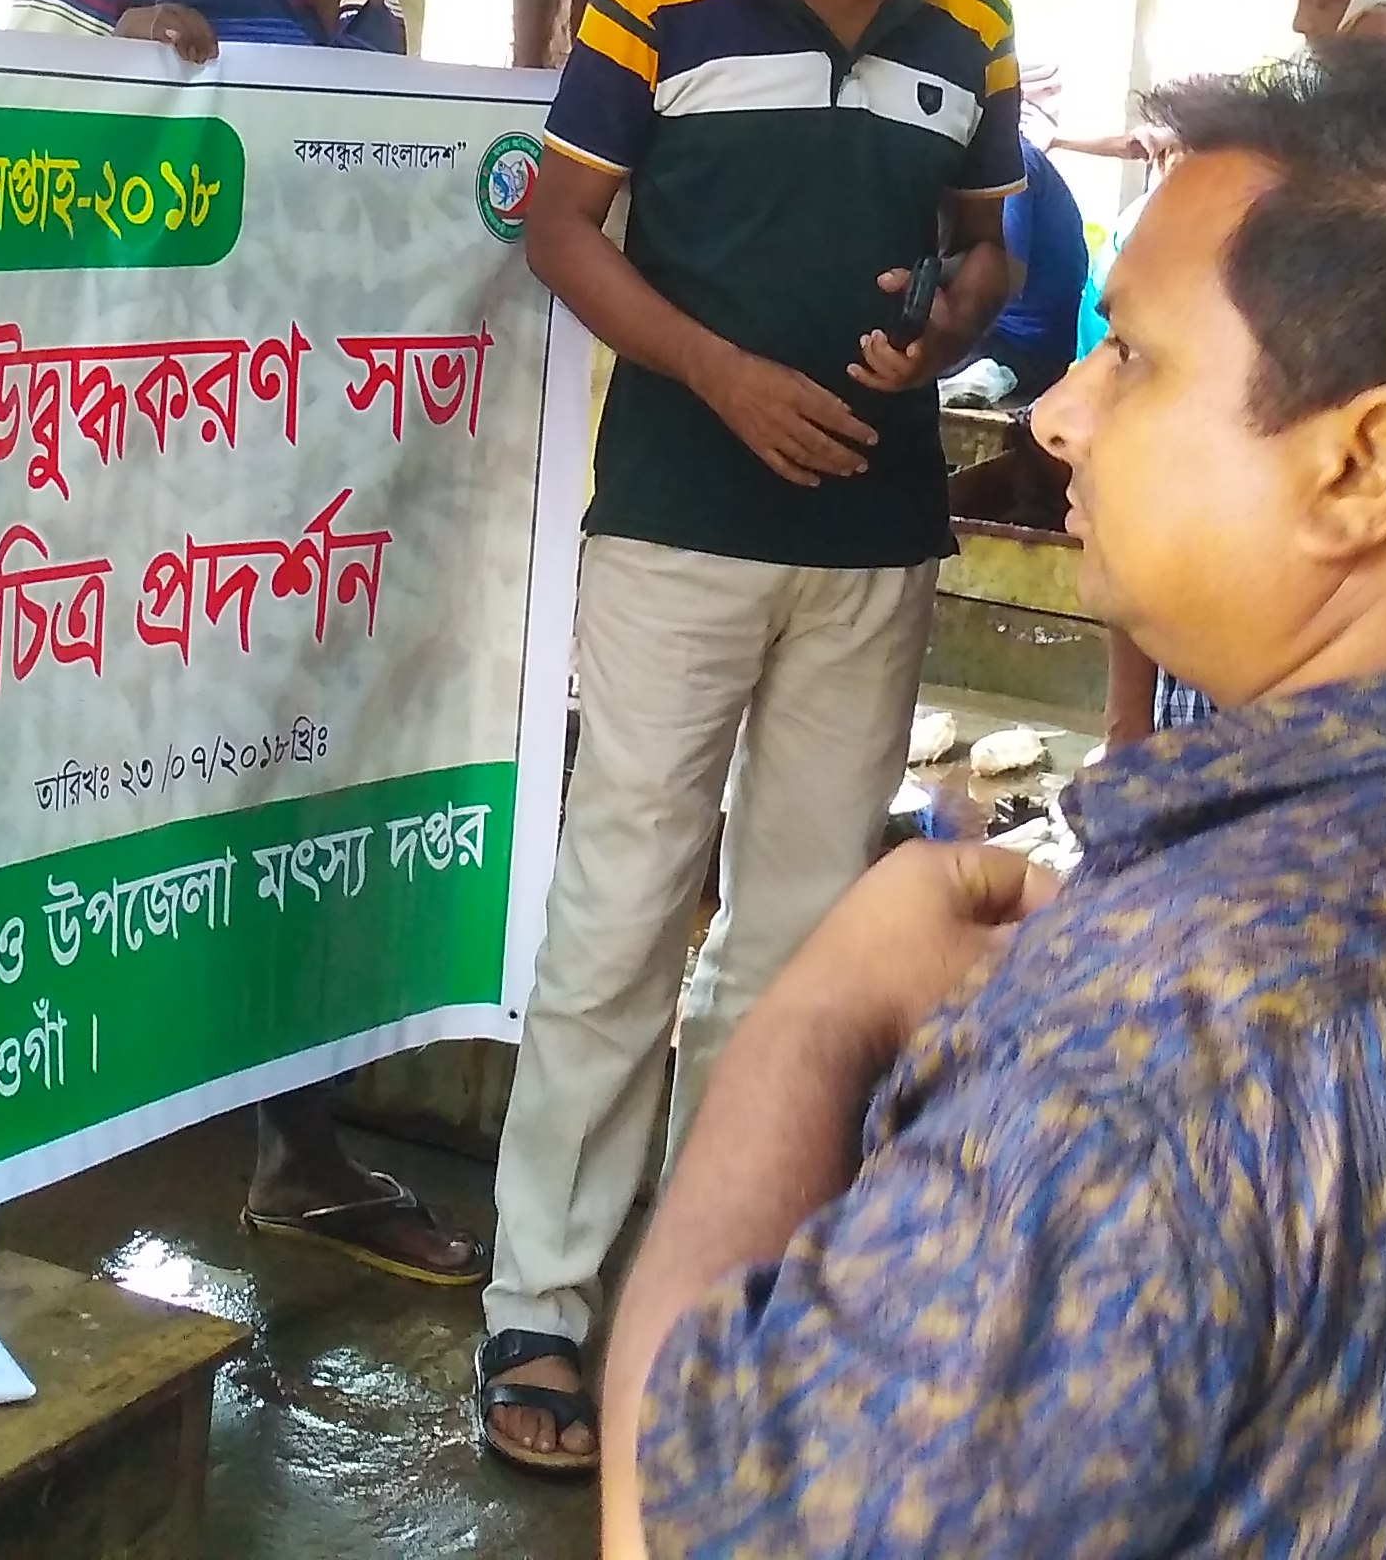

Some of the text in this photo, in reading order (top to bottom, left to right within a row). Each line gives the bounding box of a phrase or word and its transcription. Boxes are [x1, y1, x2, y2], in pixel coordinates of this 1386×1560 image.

[294, 139, 365, 173] বঙ্গবন্ধুর
[336, 319, 495, 441] সভা
[137, 488, 393, 667] প্রদর্শন
[34, 759, 110, 811] তারিখঃ
[42, 845, 237, 966] উপজেলা
[251, 825, 374, 913] মৎস্য
[387, 801, 493, 882] দপ্তর
